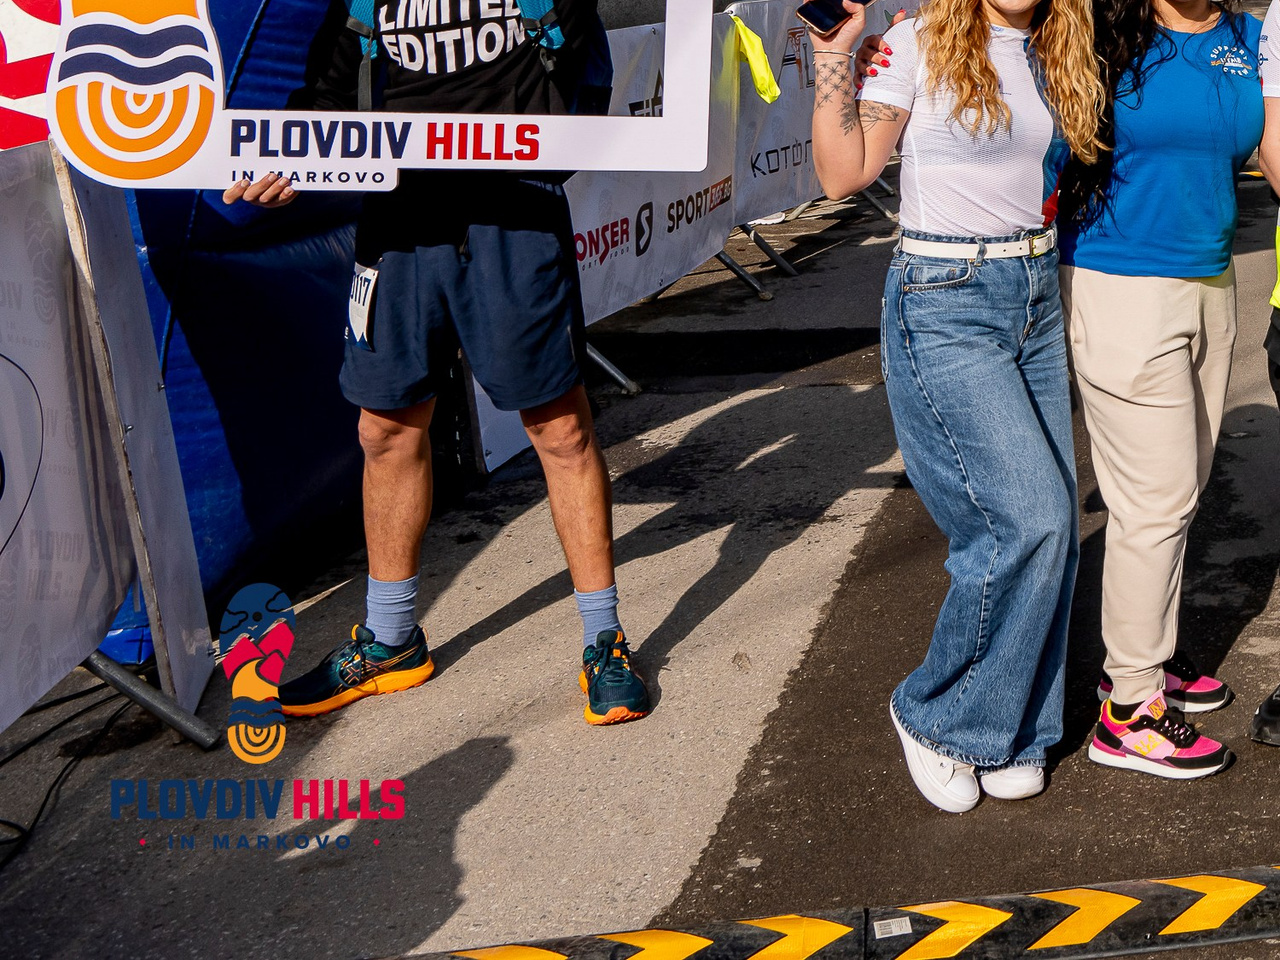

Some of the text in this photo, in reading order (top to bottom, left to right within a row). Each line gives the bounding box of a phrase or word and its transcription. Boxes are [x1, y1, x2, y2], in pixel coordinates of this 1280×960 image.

[381, 18, 526, 74] EDITION
[230, 118, 540, 161] PLOVDIV HILLS
[231, 170, 254, 182] IN
